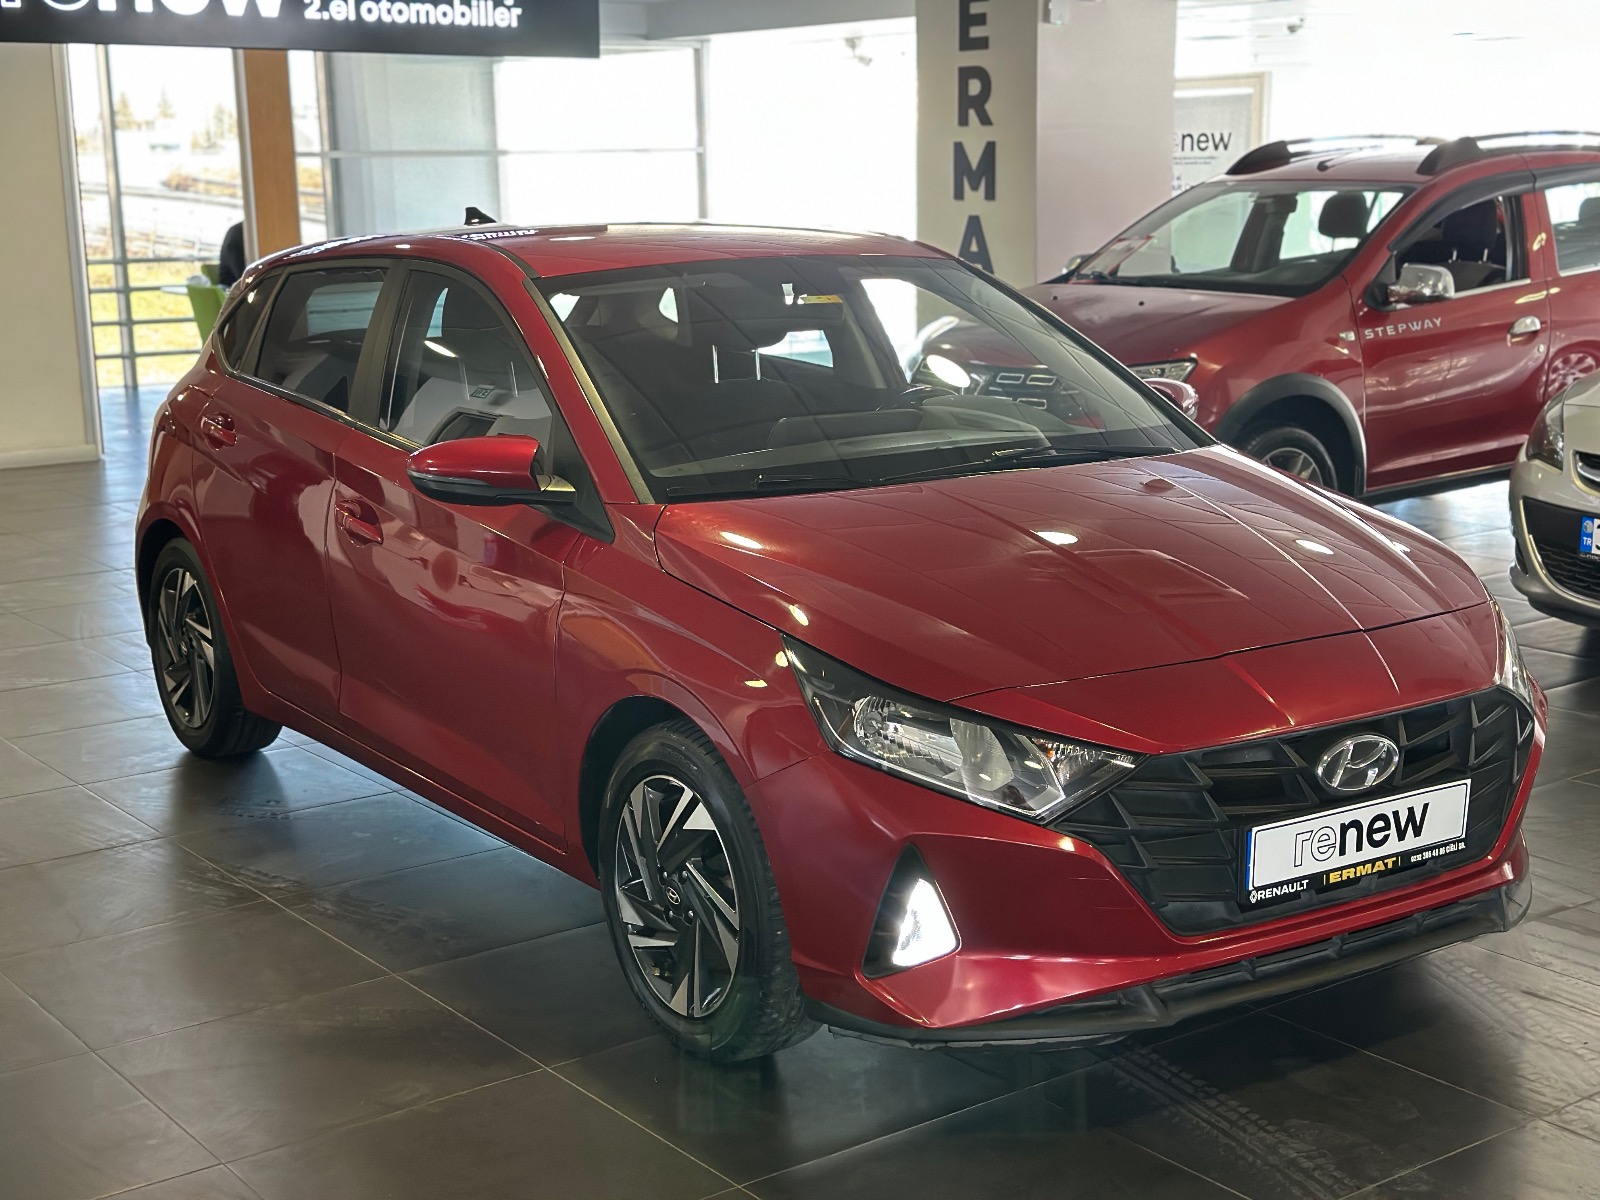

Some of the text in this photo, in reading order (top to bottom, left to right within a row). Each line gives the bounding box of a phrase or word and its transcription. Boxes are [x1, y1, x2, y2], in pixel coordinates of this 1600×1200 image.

[360, 0, 523, 28] otomobiller
[1364, 317, 1443, 339] STEPWAY
[1583, 537, 1592, 546] TR
[1294, 802, 1430, 868] renew
[1329, 857, 1396, 884] ERMAT
[1258, 880, 1309, 900] RENAULT
